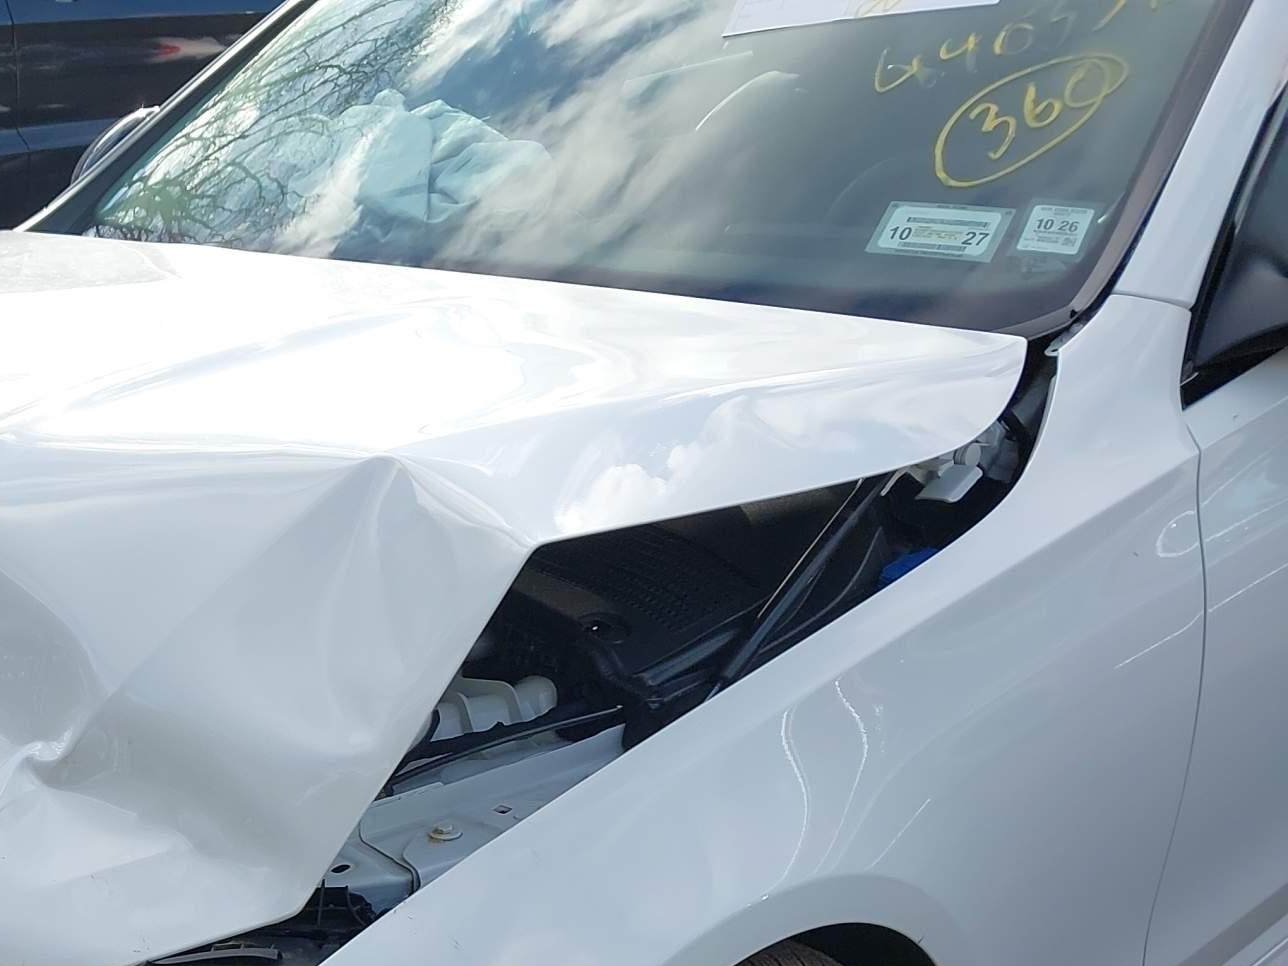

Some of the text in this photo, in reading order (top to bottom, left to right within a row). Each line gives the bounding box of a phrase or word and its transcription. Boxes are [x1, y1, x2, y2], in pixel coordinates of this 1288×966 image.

[969, 58, 1111, 161] 360
[1036, 218, 1080, 233] 10 26
[889, 226, 913, 241] 10
[961, 231, 990, 246] 27
